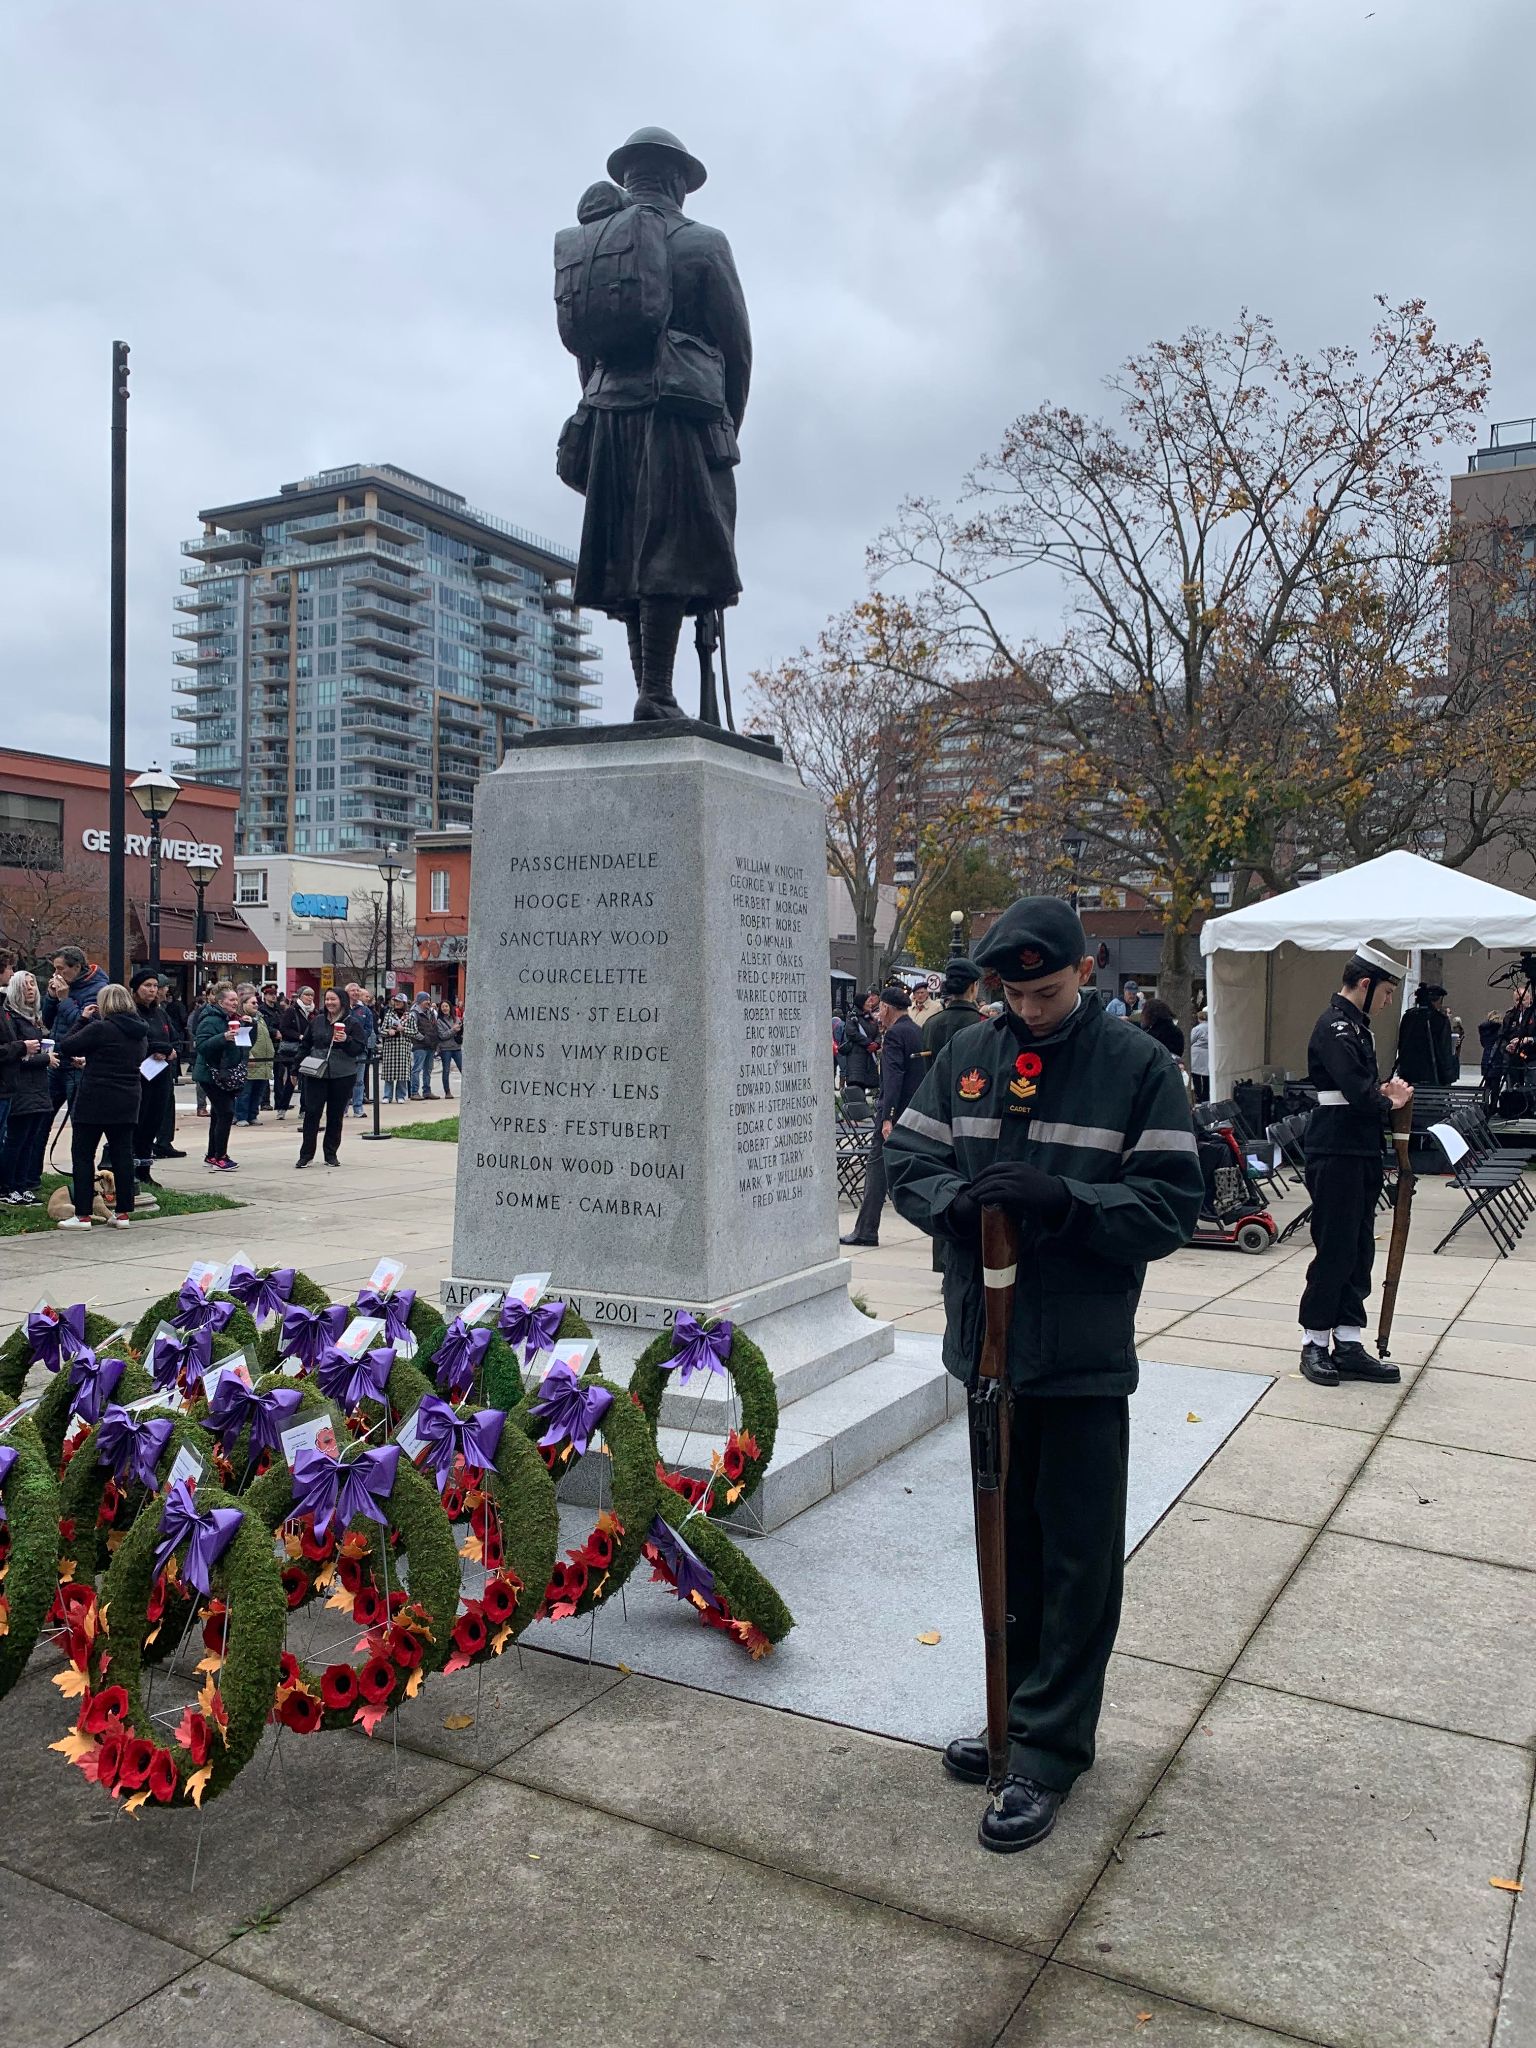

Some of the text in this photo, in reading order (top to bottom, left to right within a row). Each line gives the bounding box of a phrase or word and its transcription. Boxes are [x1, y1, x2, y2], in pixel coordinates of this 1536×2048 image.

[82, 829, 223, 865] GERY WEBER
[511, 852, 658, 872] PASSCHENDAELE
[736, 856, 803, 880] WILLIAM KNIGHT
[730, 874, 808, 899] GEORGE W LE PAGE
[514, 892, 654, 909] HOOGE ARRAS
[733, 894, 808, 915] HERBERT MORGAN
[741, 914, 801, 932] ROBERT MORSE
[500, 930, 669, 947] SANCTUARY WOOD
[210, 951, 237, 961] WEBER
[741, 952, 803, 967] ALBERT OAKES
[518, 969, 648, 984] COURCELETTE
[738, 970, 758, 983] FRED
[771, 972, 806, 985] PEPPIATT
[778, 990, 807, 1003] POTTER
[504, 1006, 659, 1023] AMIENS ST ELOI
[744, 1008, 801, 1021] ROBERT REESE
[746, 1026, 800, 1039] ERIC ROWLEY
[495, 1043, 669, 1062] MONS VIMY RIDGE
[752, 1044, 796, 1058] ROY SMITH
[740, 1060, 807, 1077] STANLEY SMITH
[500, 1080, 660, 1100] GIVENCHY LENS
[737, 1078, 811, 1096] EDWARD SUMMERS
[730, 1094, 818, 1116] EDWIN H STEPHENSON
[1010, 1105, 1031, 1113] CADET
[489, 1116, 671, 1140] YPRES FESTUBERT
[738, 1120, 764, 1135] EDGAR
[777, 1113, 812, 1129] SIMMONS
[738, 1131, 812, 1154] ROBERT SAUNDERS
[476, 1153, 685, 1180] BOURLON WOOD DOUAI
[747, 1149, 804, 1170] WALTER TARRY
[740, 1176, 762, 1192] MARK
[778, 1166, 813, 1184] WILLIAMS
[495, 1190, 662, 1218] SOMME CAMBRAI
[753, 1186, 802, 1208] FRED WALSH
[595, 1301, 637, 1323] 2001
